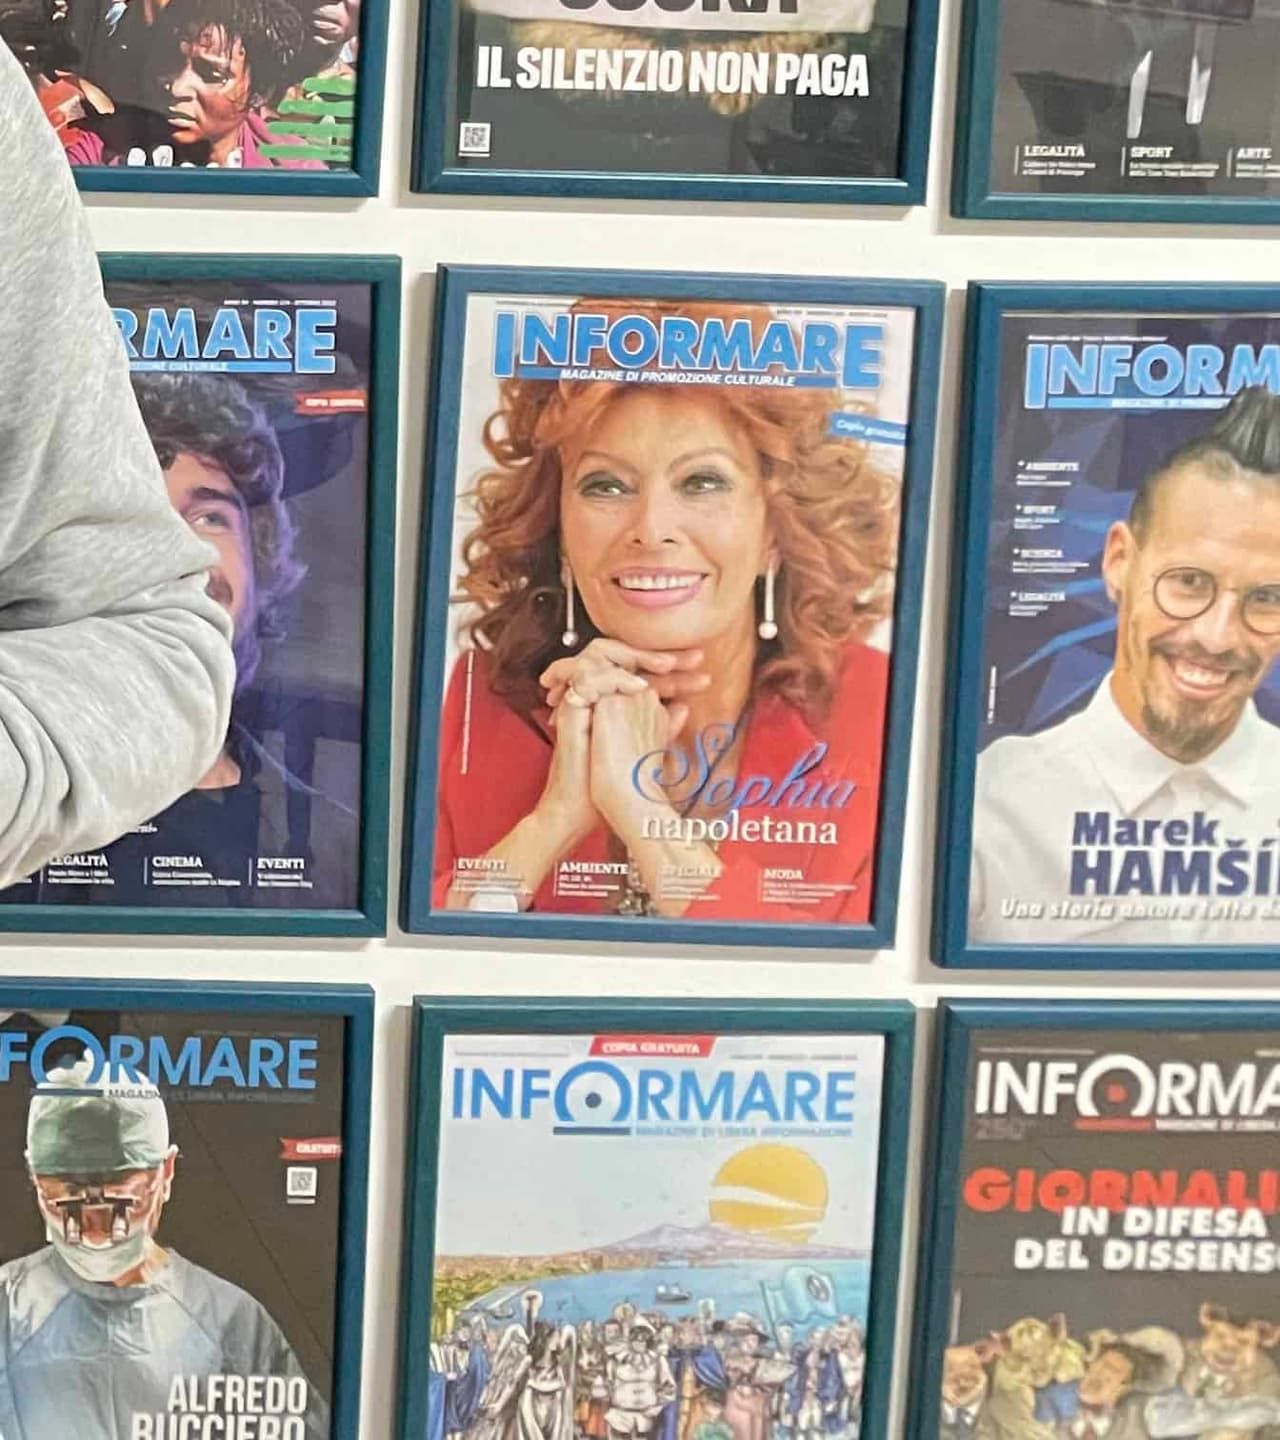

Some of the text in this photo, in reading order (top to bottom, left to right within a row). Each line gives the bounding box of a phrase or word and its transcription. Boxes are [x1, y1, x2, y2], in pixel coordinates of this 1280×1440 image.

[476, 45, 870, 97] IL SILENZIO NON PAGA
[493, 311, 885, 389] INFORMARE
[560, 369, 796, 387] MAGAZINE DI PROMOZIONE CULTURALE
[631, 722, 858, 832] Sophia
[640, 815, 838, 847] napoletana
[1072, 811, 1219, 847] Marek
[152, 855, 204, 869] CINEMA
[257, 858, 305, 869] EVENTI
[559, 861, 629, 875] AMBIENTE
[764, 868, 803, 881] MODA
[601, 1041, 701, 1056] COPIA GRATUITA
[451, 1060, 856, 1122] INFORMARE
[1060, 1206, 1268, 1237] IN DIFESA
[1013, 1239, 1089, 1270] DEL
[167, 1374, 308, 1413] ALFREDO
